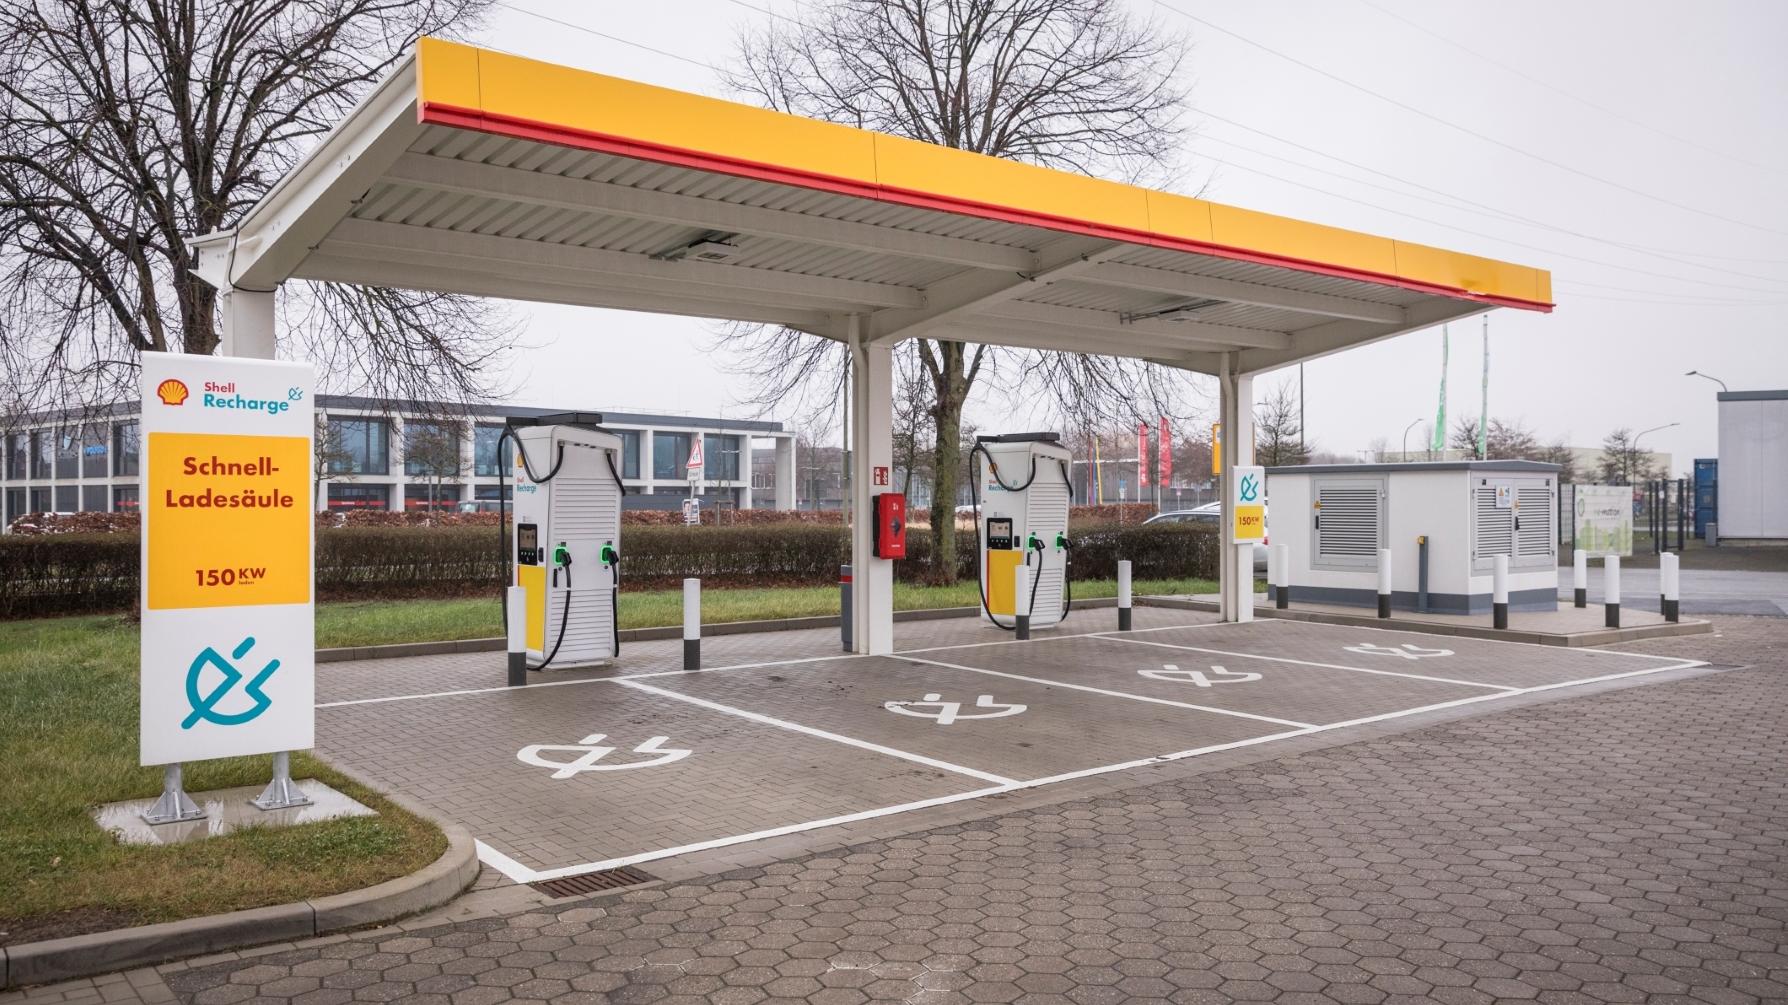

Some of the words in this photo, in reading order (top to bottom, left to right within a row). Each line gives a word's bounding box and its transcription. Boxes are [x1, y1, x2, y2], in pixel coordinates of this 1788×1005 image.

[204, 381, 235, 393] Shell
[203, 393, 289, 415] Recharge
[183, 456, 280, 476] Schnell-
[166, 488, 294, 508] Ladesäule
[1239, 516, 1251, 526] 150
[195, 568, 235, 586] 150
[238, 567, 266, 579] KW
